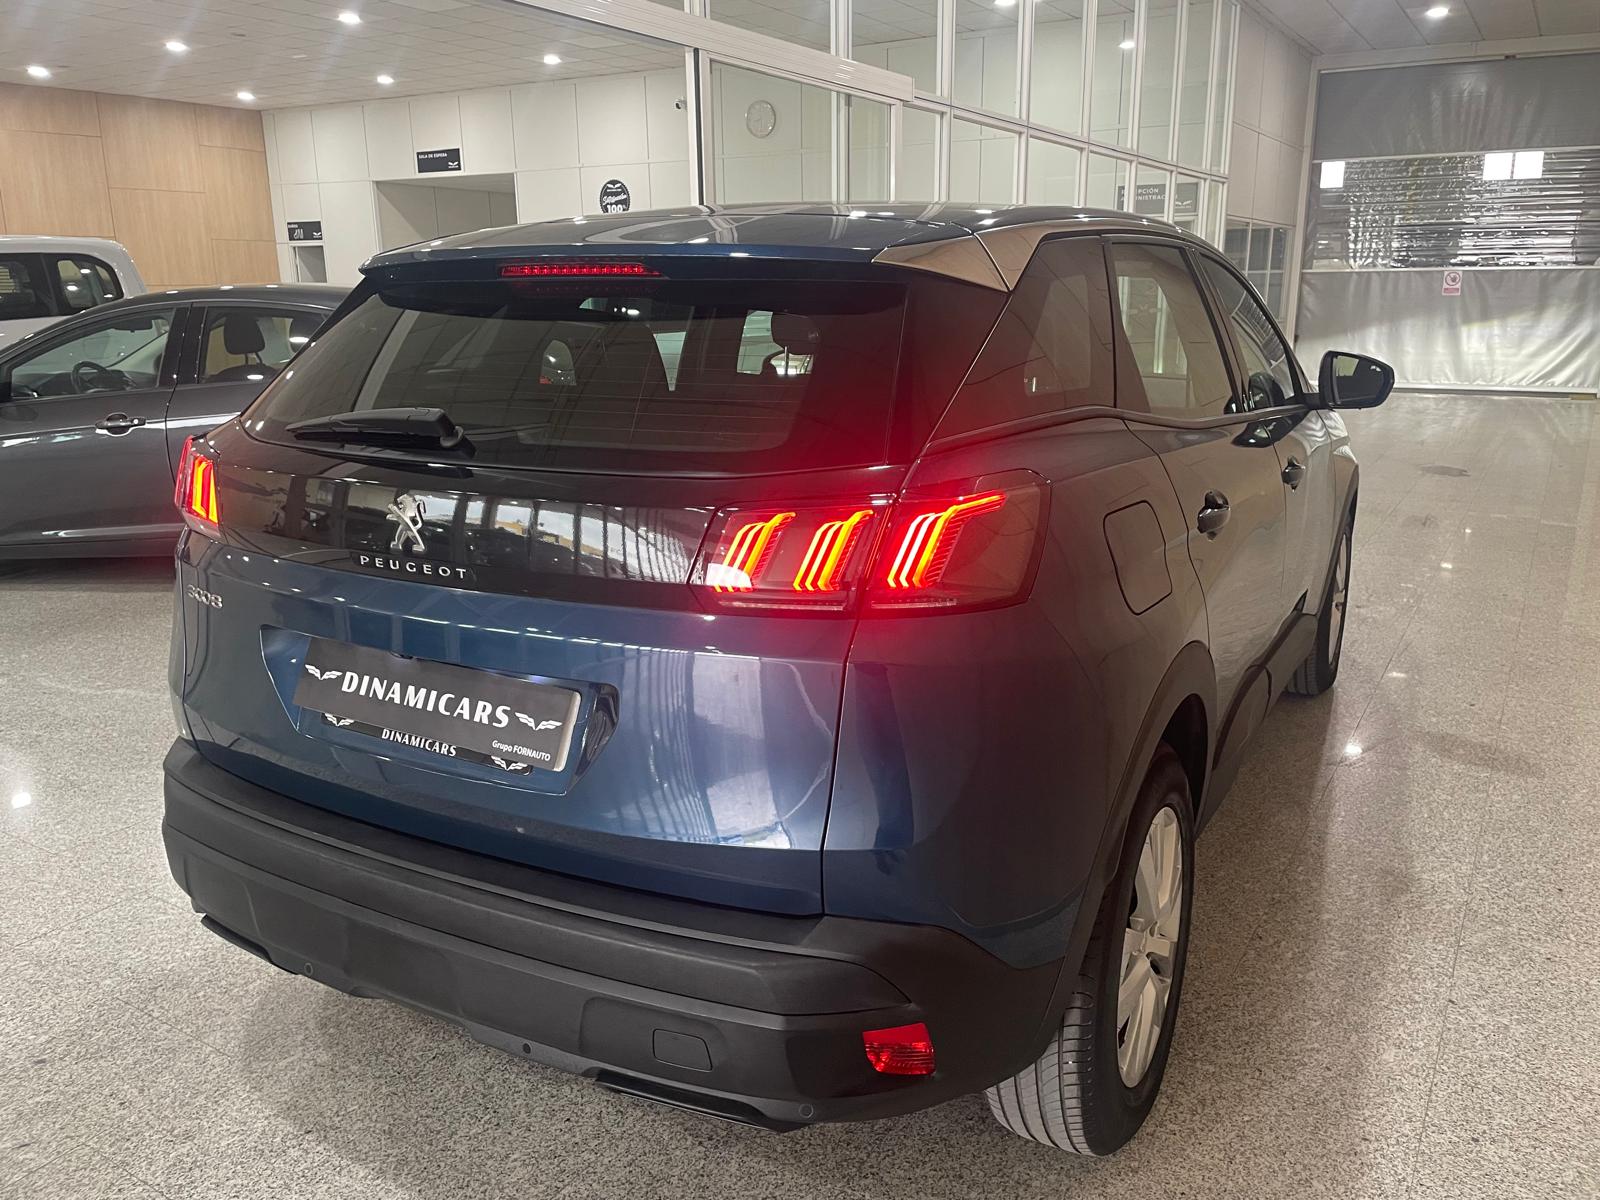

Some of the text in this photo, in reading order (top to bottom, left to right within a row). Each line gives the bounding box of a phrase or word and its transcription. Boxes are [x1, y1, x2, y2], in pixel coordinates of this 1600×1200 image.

[360, 555, 467, 579] PEUGEOT
[187, 584, 223, 609] 3008
[341, 671, 511, 728] DINAMICARS
[381, 728, 457, 757] DINAMICARS
[492, 740, 551, 762] Grupo FORNAUTO
